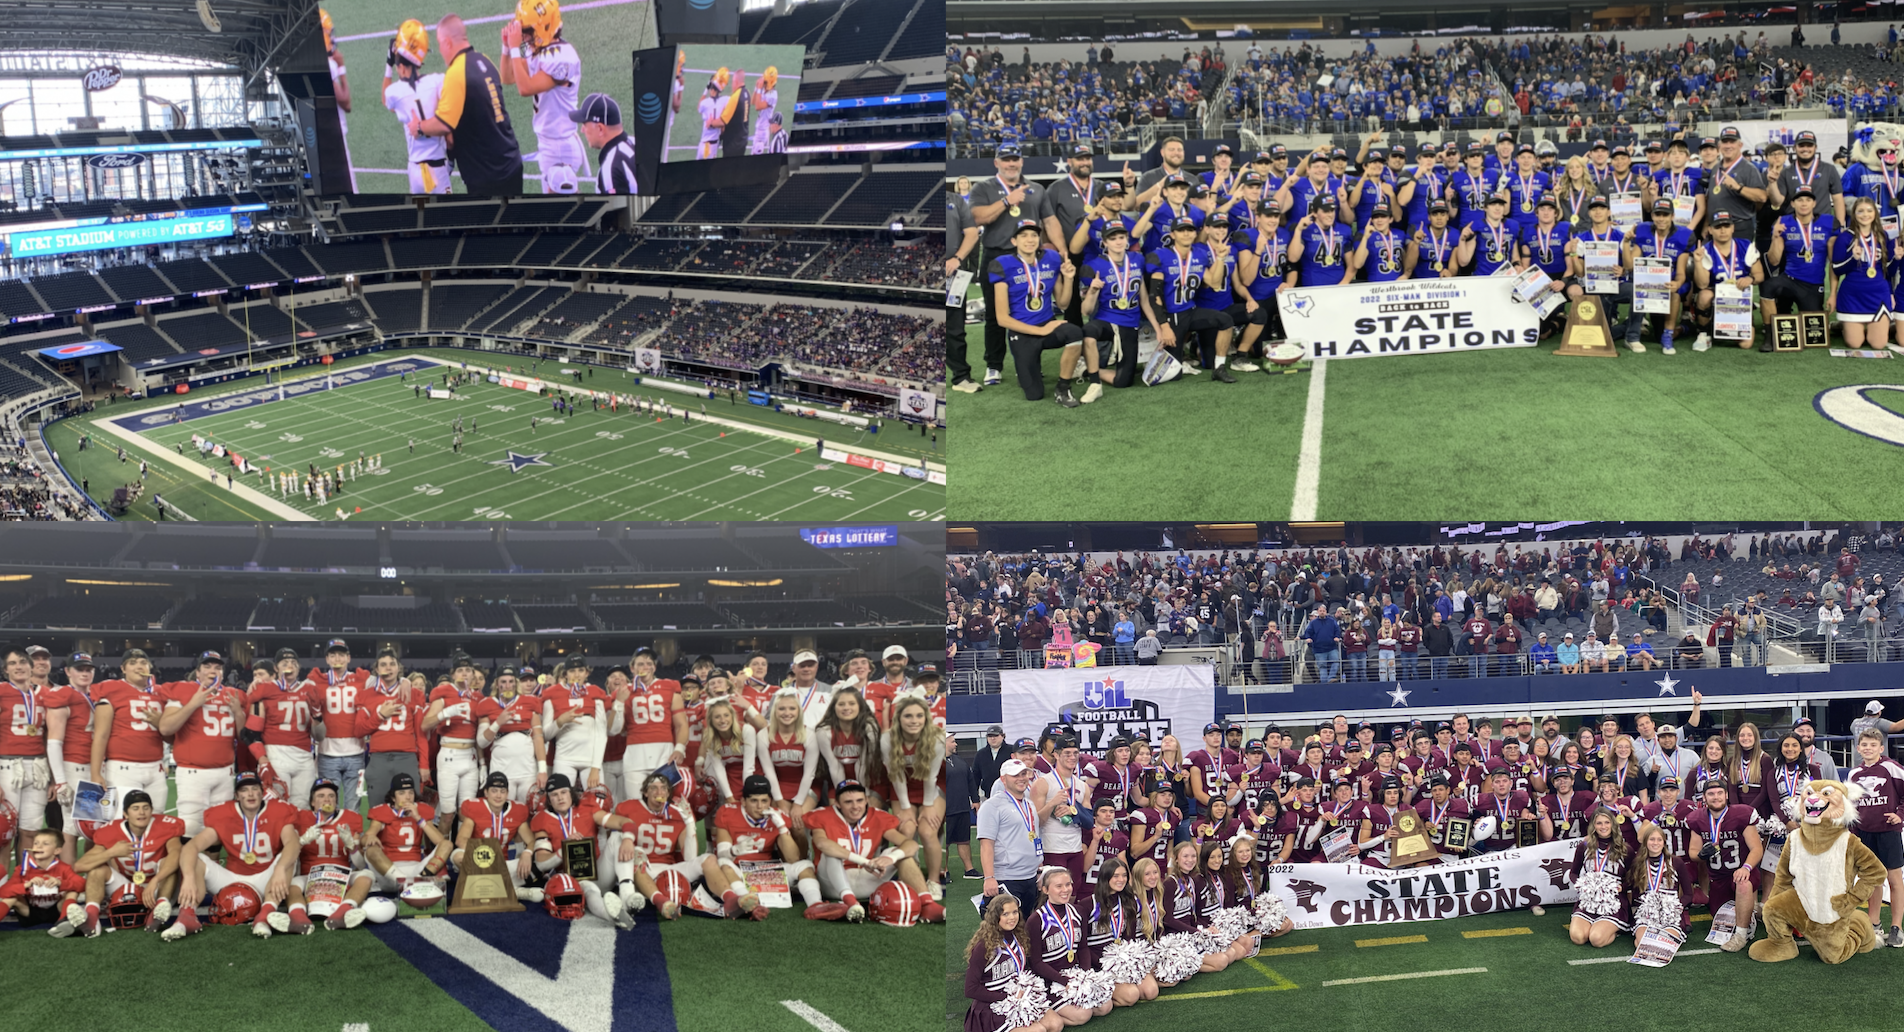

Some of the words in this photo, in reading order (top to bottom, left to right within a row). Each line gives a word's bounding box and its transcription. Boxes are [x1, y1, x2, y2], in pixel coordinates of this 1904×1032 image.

[88, 71, 120, 90] Pepper
[99, 68, 112, 79] Dr
[99, 154, 137, 167] Ford
[19, 236, 52, 251] AT&T
[56, 230, 115, 247] STADIUM
[118, 228, 158, 240] POWERED
[161, 226, 171, 236] BY
[173, 221, 204, 236] AT&T
[206, 219, 225, 232] 5G
[1313, 241, 1342, 267] 44
[1649, 266, 1669, 274] CHAMPS
[1174, 275, 1200, 305] 18
[1360, 295, 1381, 304] 2022
[1387, 292, 1420, 302] SIX-MAN
[1427, 291, 1460, 300] DIVISION
[1380, 304, 1405, 312] BACK
[1409, 303, 1419, 311] to
[1423, 302, 1448, 310] BACK
[1354, 311, 1473, 335] STATE
[1314, 328, 1538, 357] HAMPIONS
[413, 483, 444, 496] 50
[811, 534, 842, 544] TEXAS
[846, 532, 885, 543] LOTTERY
[1200, 610, 1210, 618] 45
[326, 686, 357, 714] 88
[818, 695, 826, 703] A
[1084, 680, 1131, 708] UIL
[278, 701, 310, 731] 70
[632, 695, 665, 724] 66
[1077, 710, 1141, 721] FOOTBALL
[202, 705, 234, 736] 52
[1247, 781, 1271, 789] EARCATS
[1859, 796, 1888, 807] AWLEY
[398, 827, 415, 851] 3
[637, 823, 674, 855] 65
[1553, 819, 1581, 840] 74
[1701, 831, 1737, 840] BEACATS
[233, 832, 274, 863] 79
[315, 834, 342, 858] 11
[477, 851, 491, 860] UIL
[1255, 840, 1283, 861] 52
[573, 862, 589, 870] MVP
[1269, 865, 1294, 873] 2022
[324, 871, 349, 881] CHAMPS
[1366, 866, 1501, 900] STATE
[1330, 884, 1542, 926] CHAMPIONS
[1644, 932, 1658, 940] STATE
[1658, 935, 1679, 948] CHAMPS
